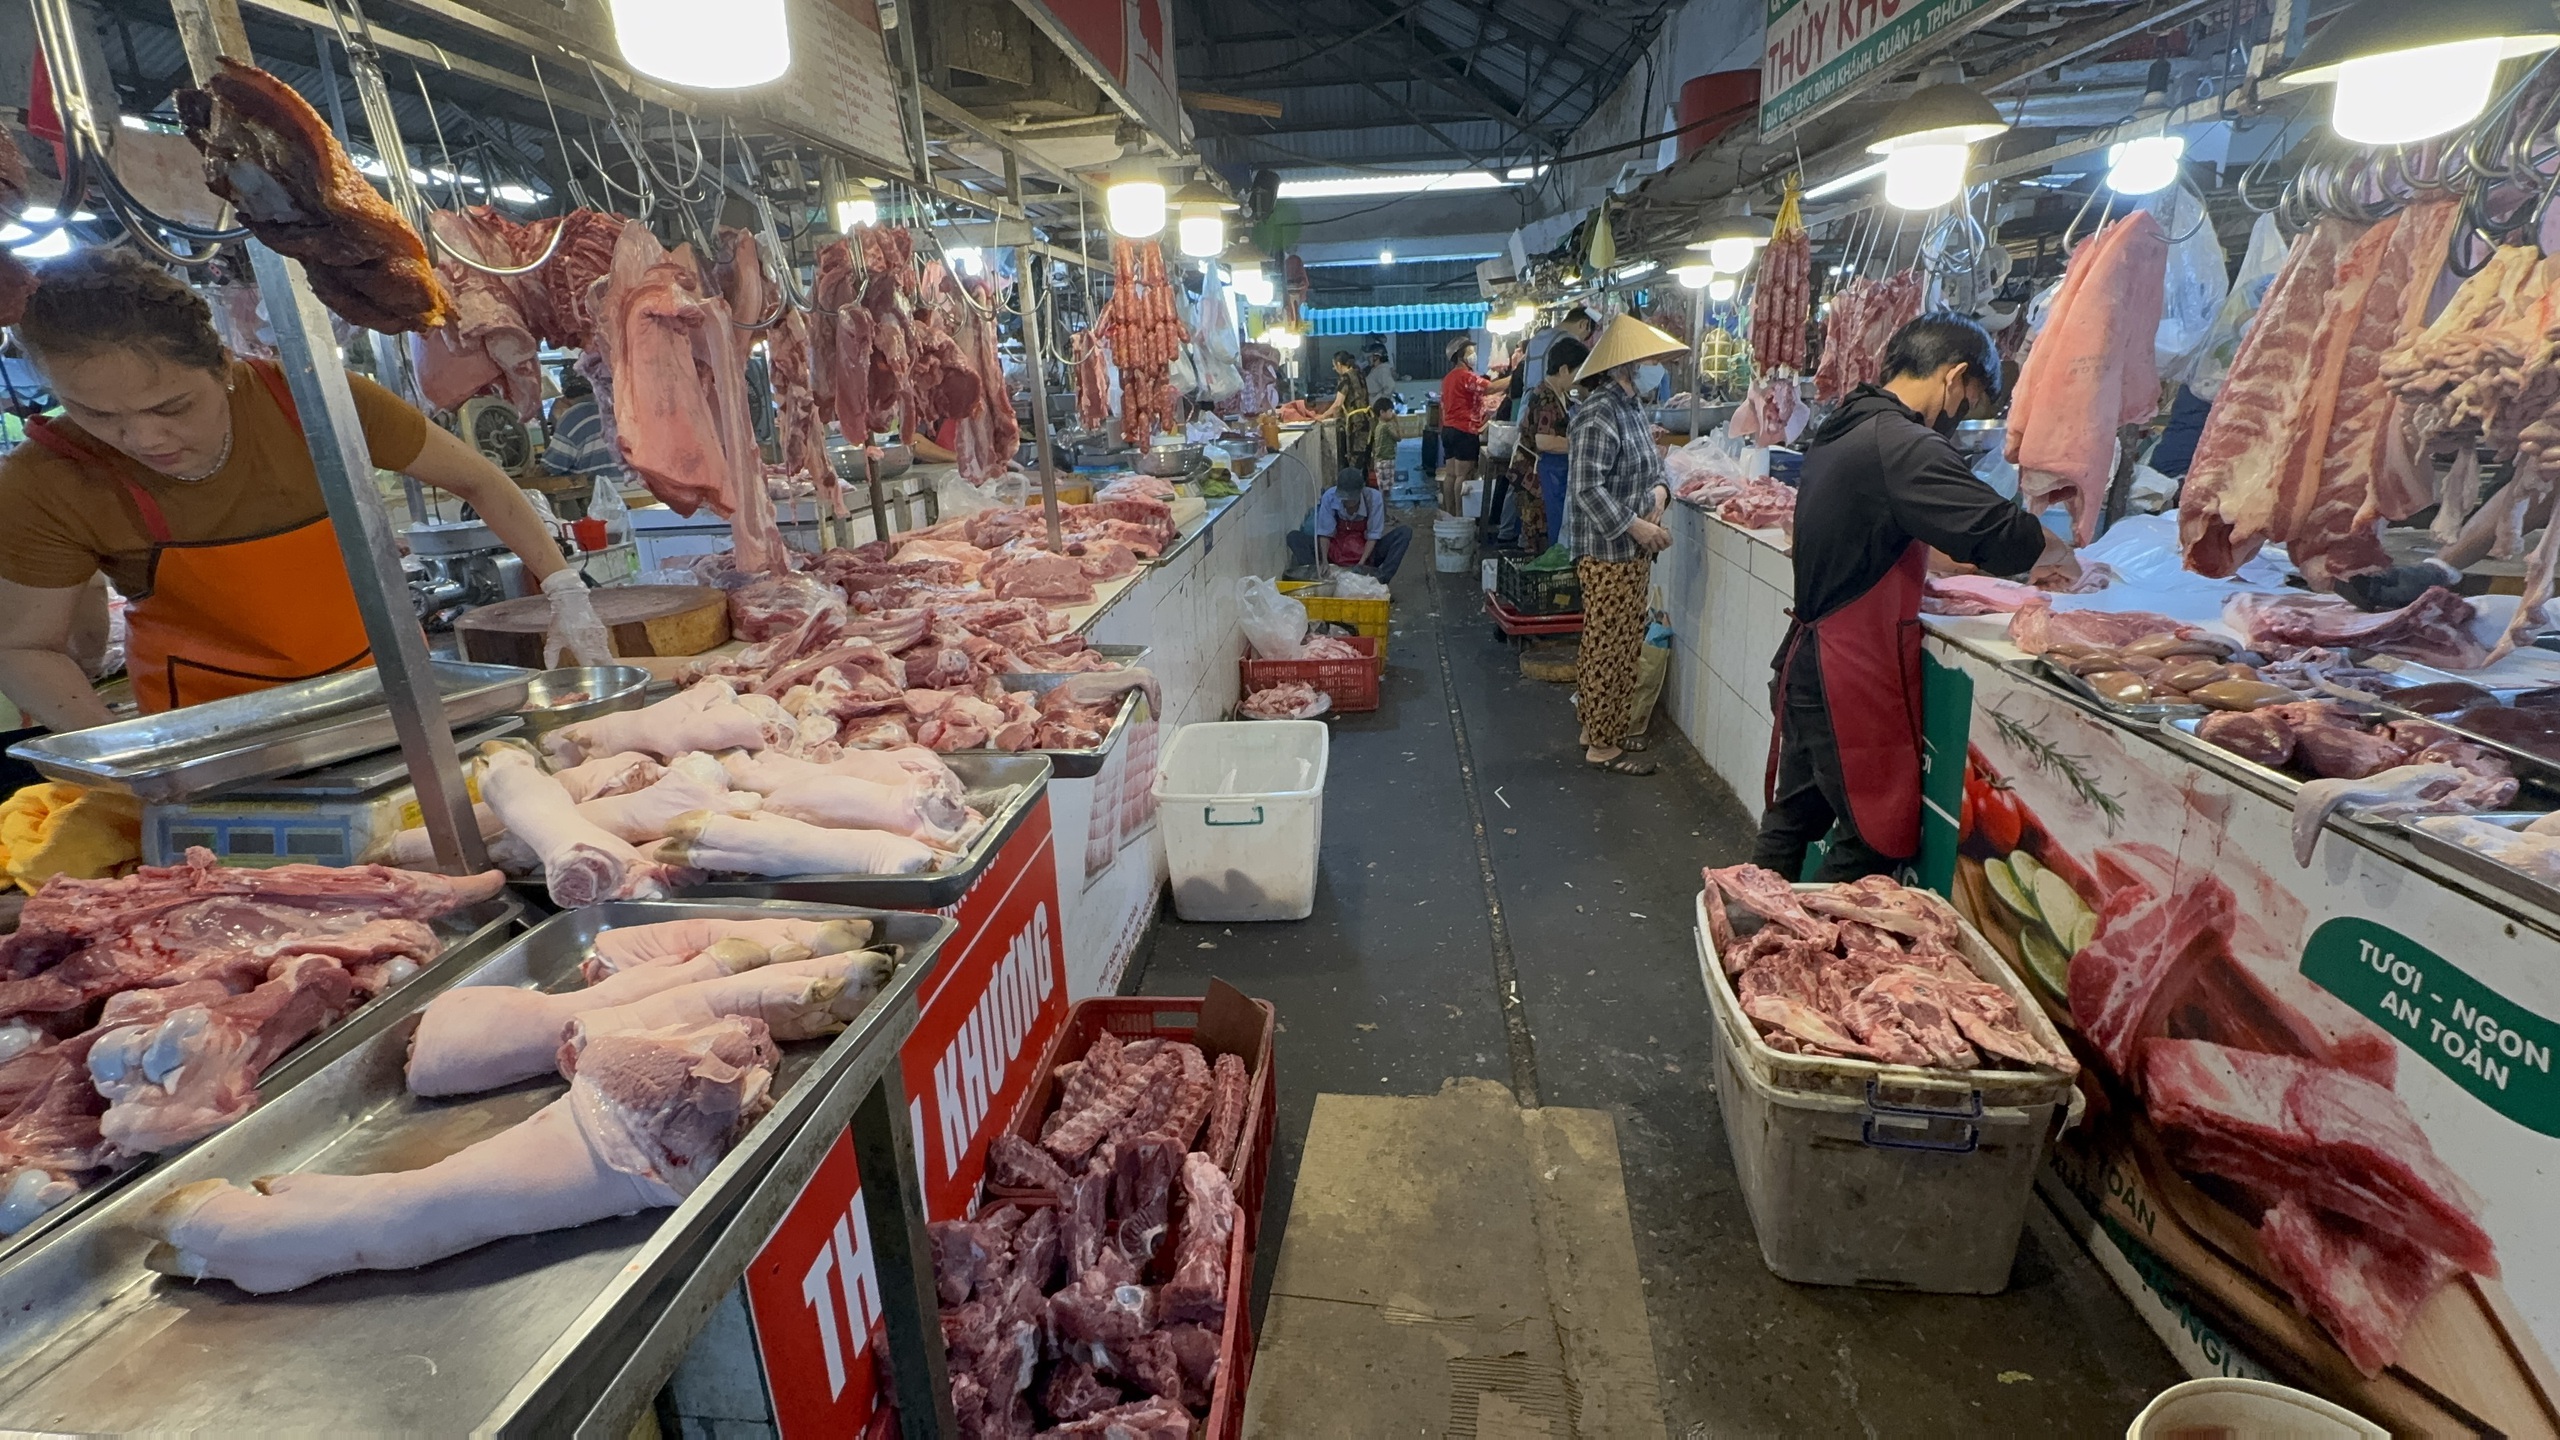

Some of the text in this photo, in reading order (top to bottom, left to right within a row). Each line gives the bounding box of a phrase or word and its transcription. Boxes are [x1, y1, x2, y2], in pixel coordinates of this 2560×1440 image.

[1768, 1, 1830, 95] THÙY
[933, 901, 1054, 1181] KHƯƠNG
[2358, 938, 2424, 995] TƯƠI
[2451, 998, 2550, 1074] NGON
[2379, 990, 2510, 1091] AN TOÀN
